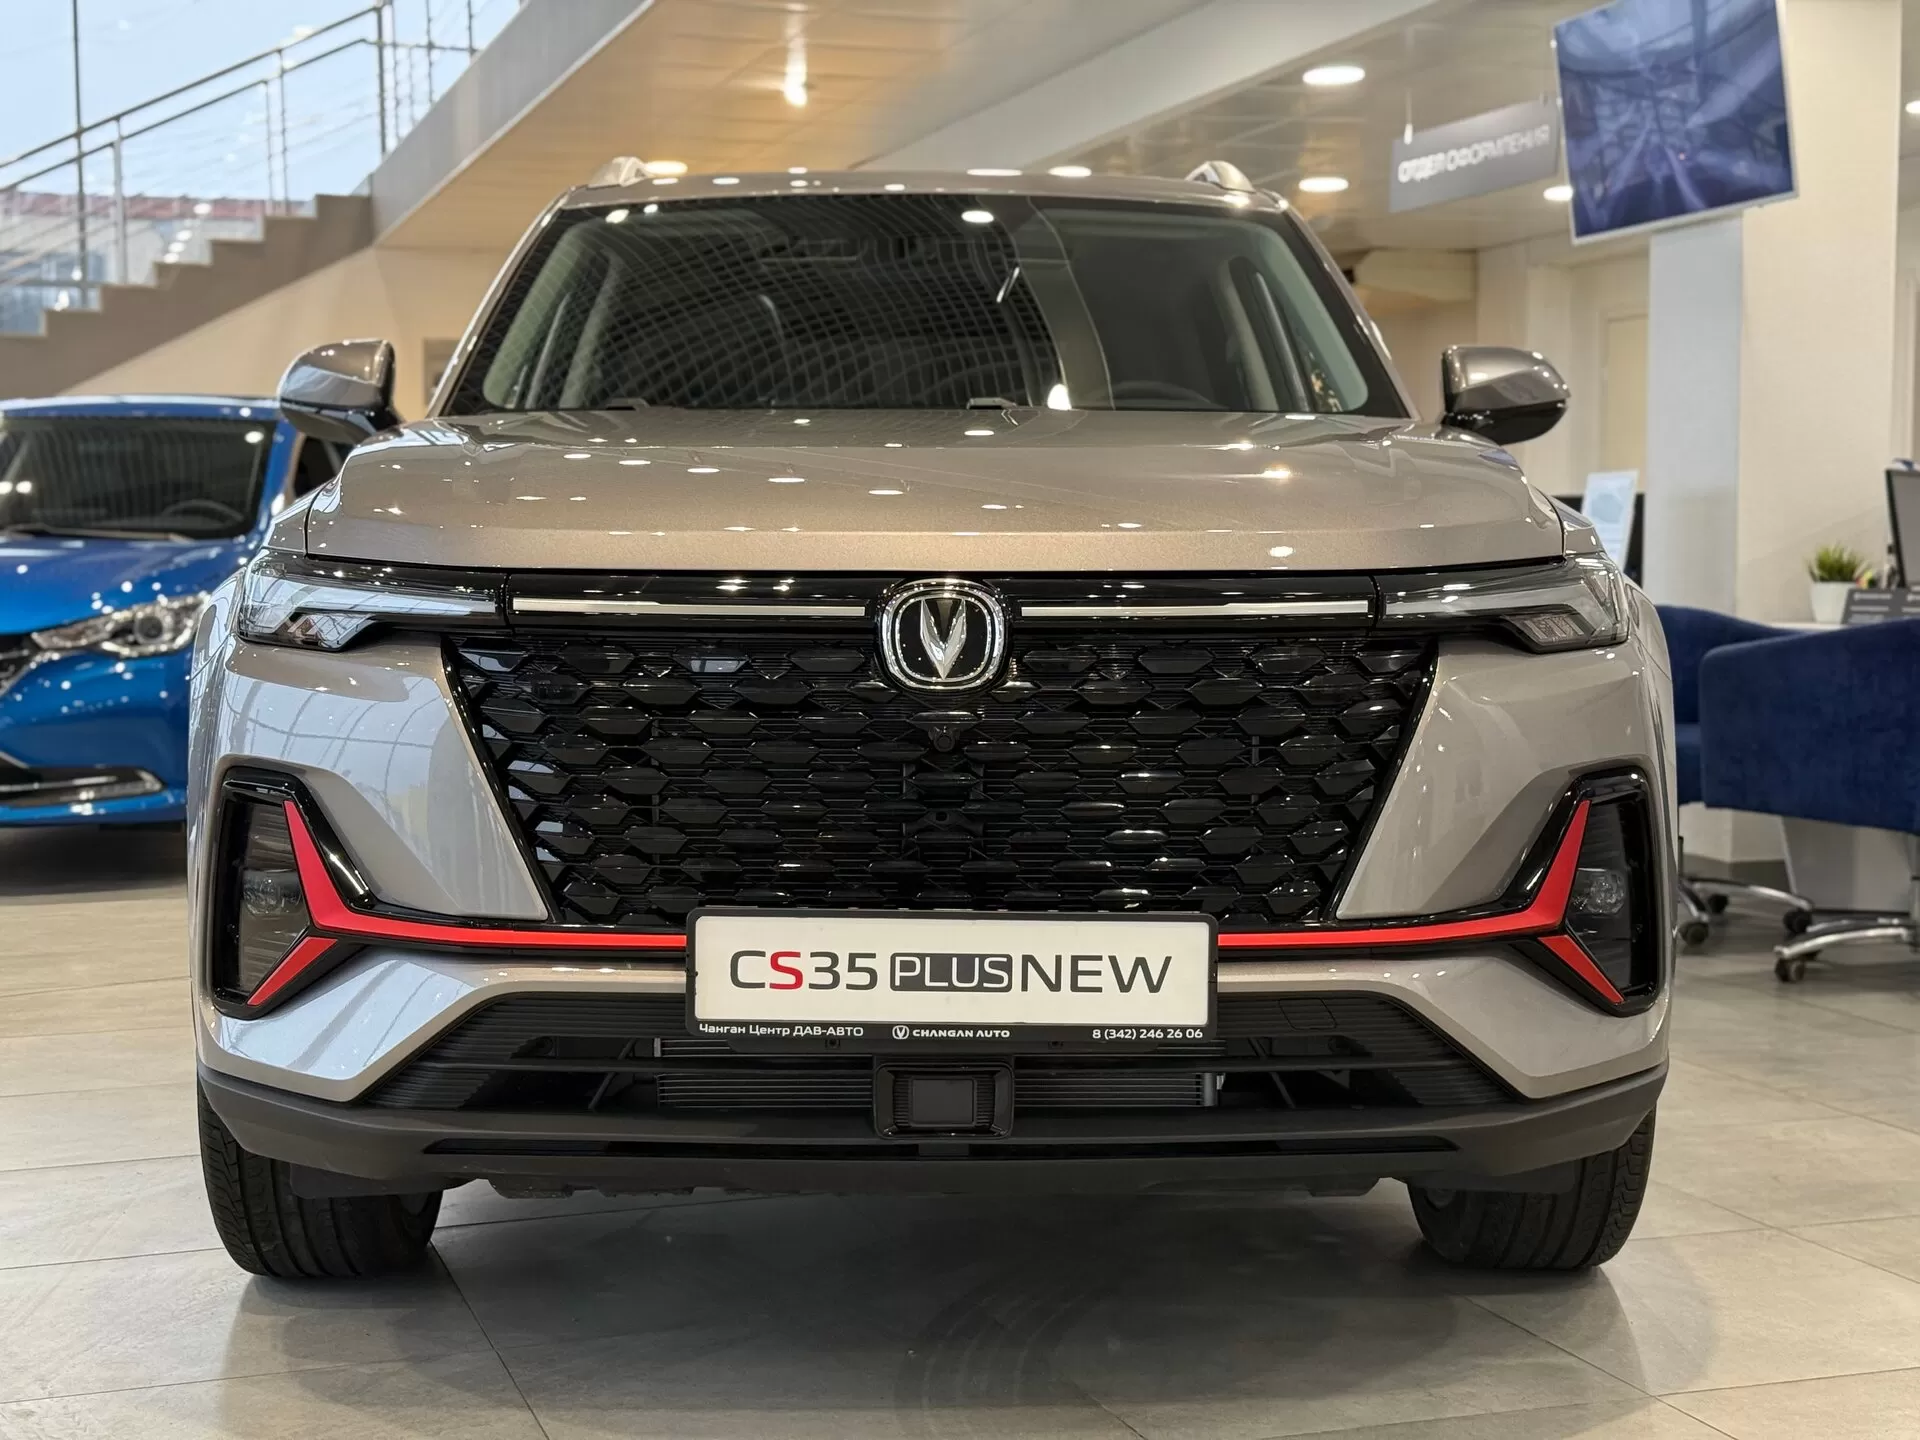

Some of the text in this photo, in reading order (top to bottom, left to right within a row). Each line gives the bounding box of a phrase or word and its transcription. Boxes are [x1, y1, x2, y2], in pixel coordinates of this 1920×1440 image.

[729, 950, 1173, 993] CS35 PLUS NEW
[699, 1024, 864, 1037] Чанган Центр ДАВ-АВТО
[912, 1028, 1010, 1038] CHANGAN AUTO
[1092, 1029, 1203, 1040] 8 (342) 246 26 06
